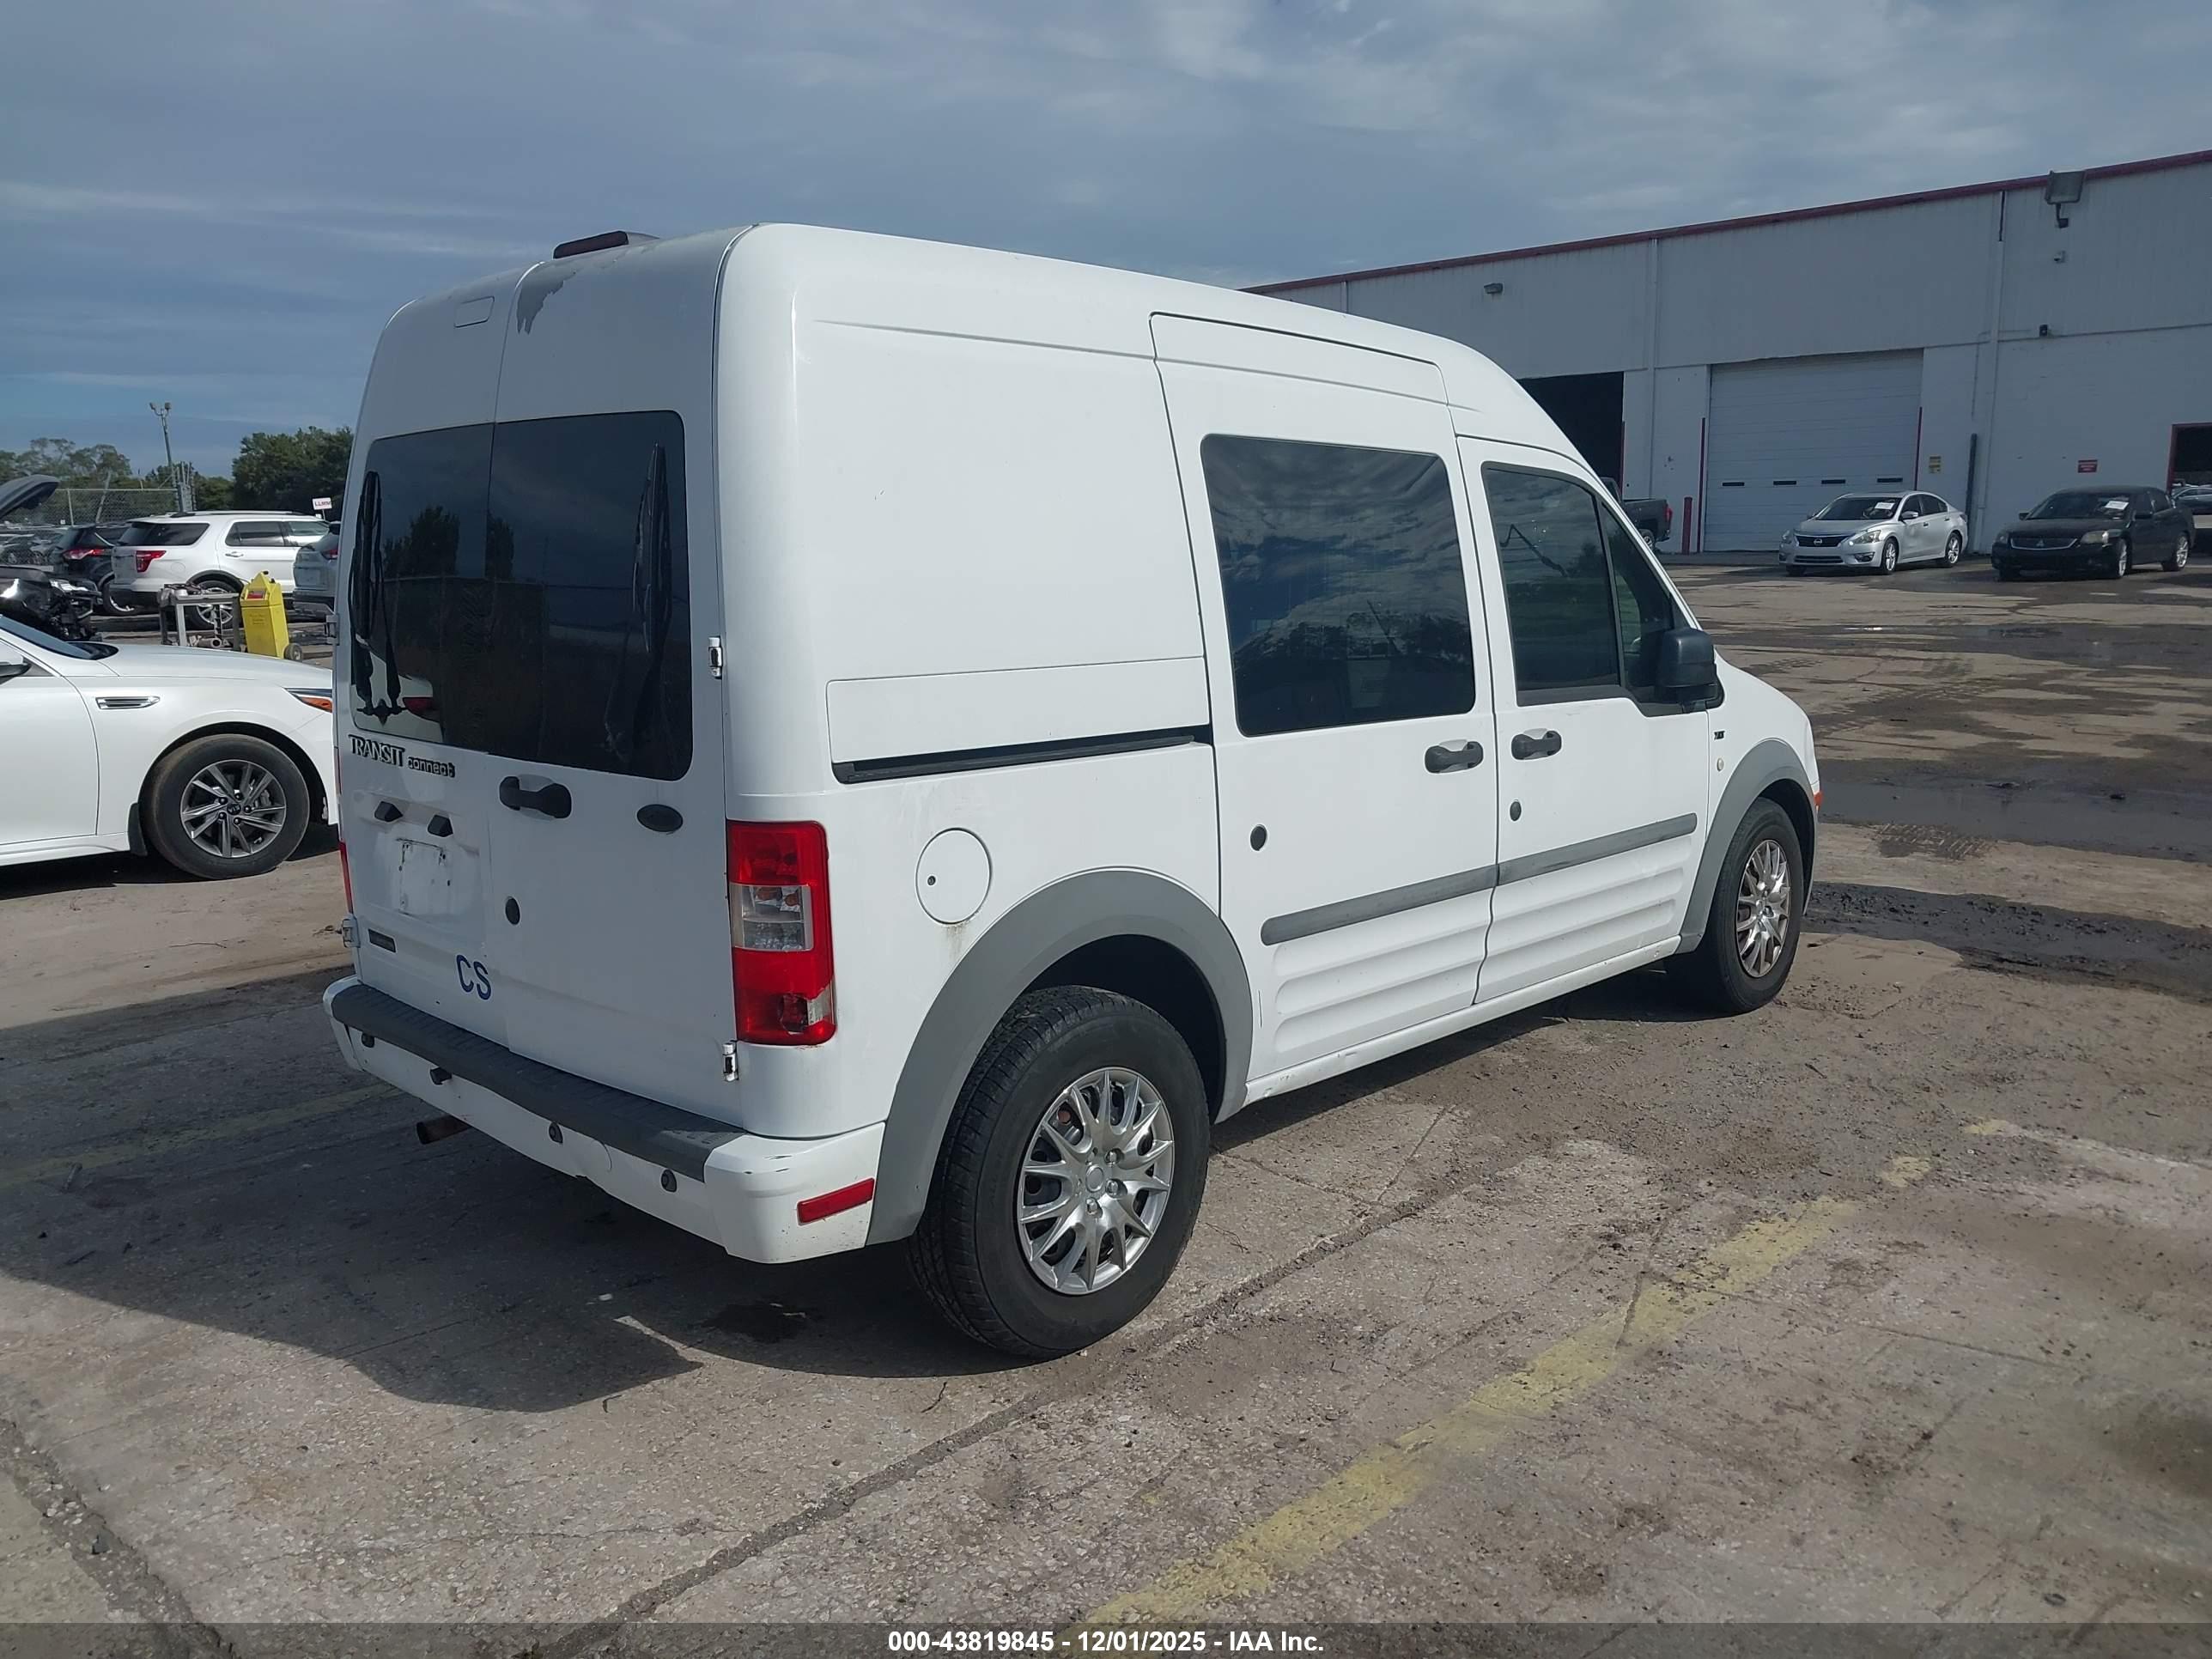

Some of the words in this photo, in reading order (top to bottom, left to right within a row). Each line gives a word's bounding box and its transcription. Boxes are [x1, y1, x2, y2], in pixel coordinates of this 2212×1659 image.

[348, 733, 405, 767] TRANSIT
[408, 757, 456, 778] connect
[456, 954, 492, 1000] CS
